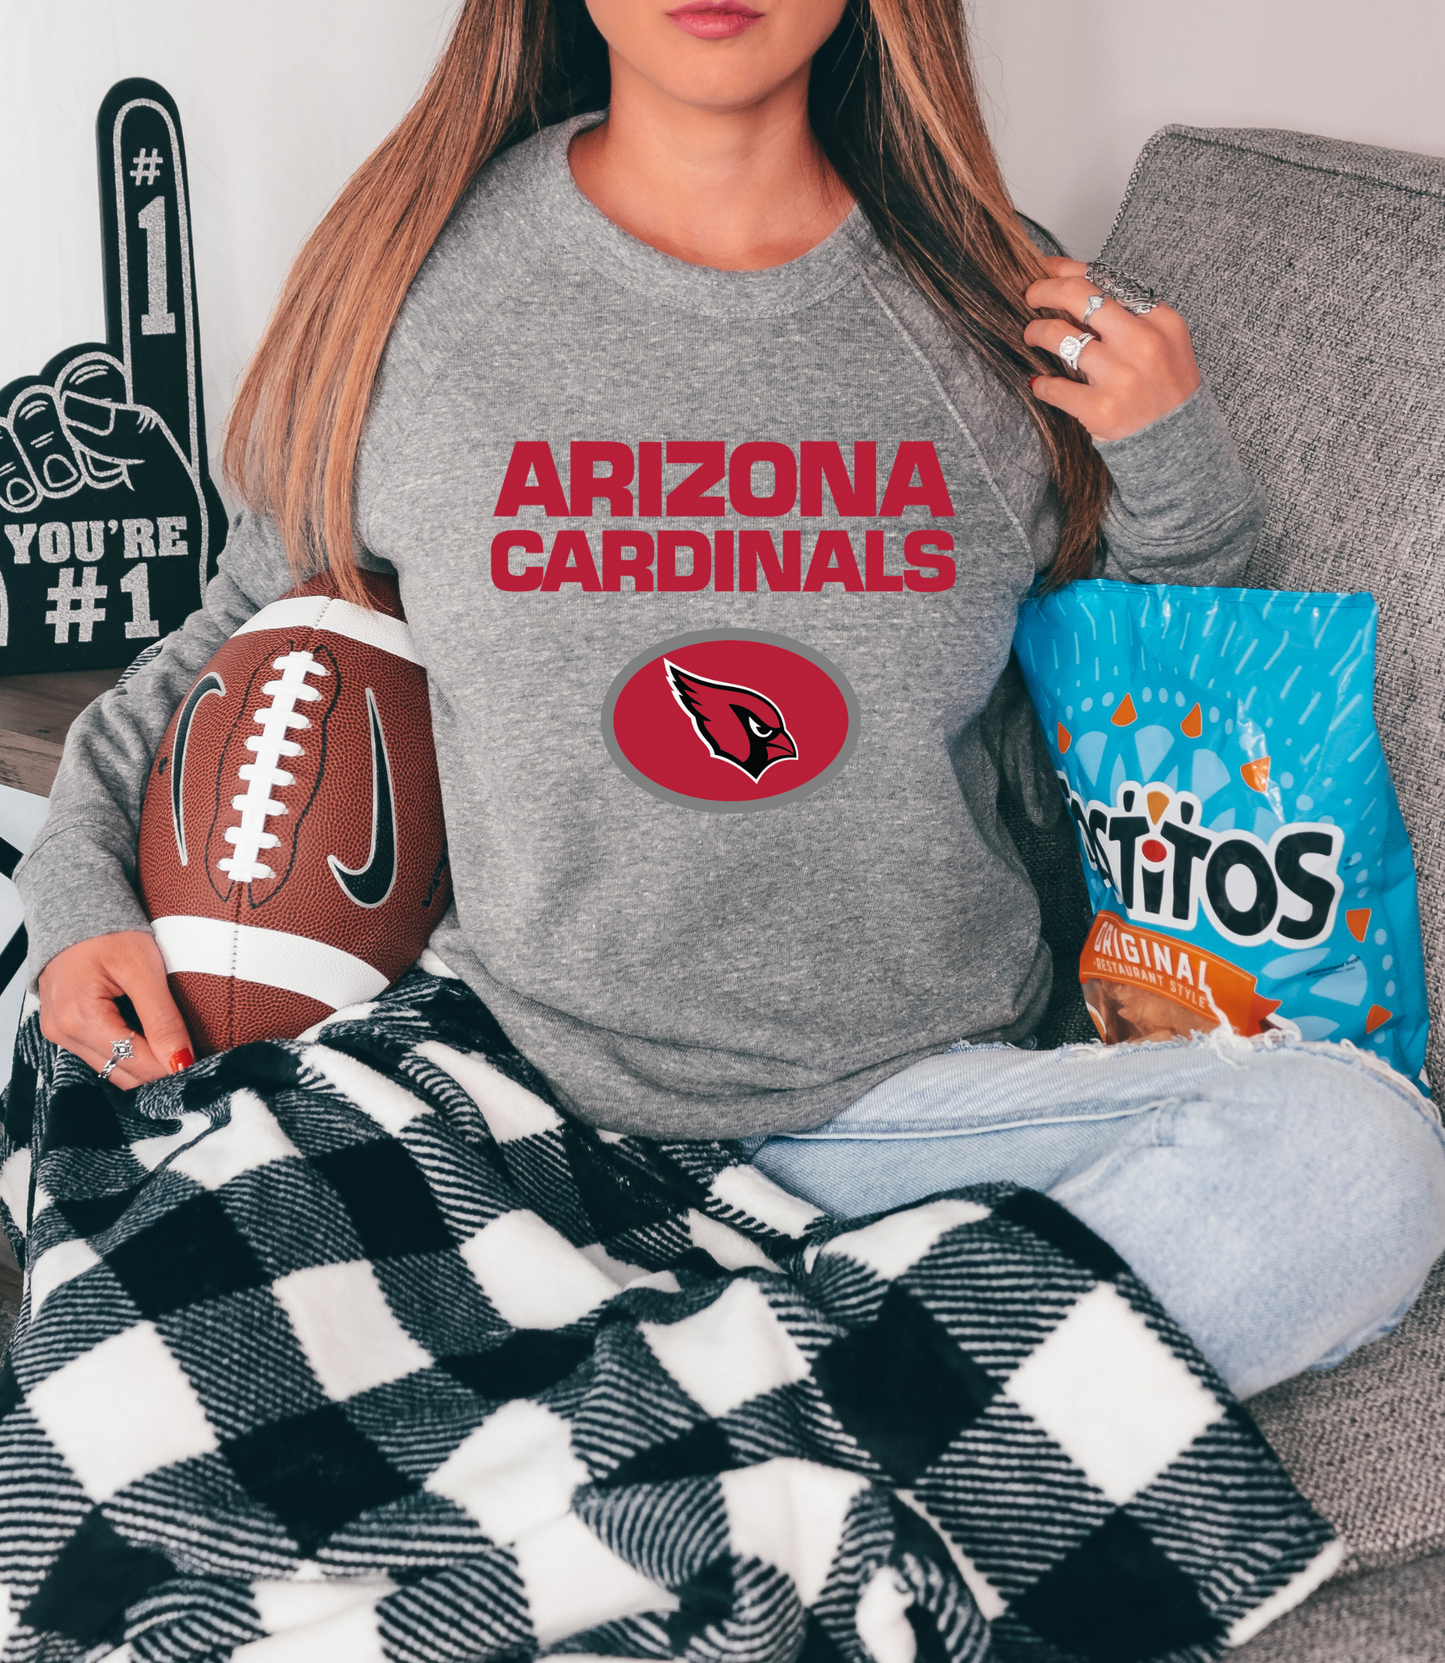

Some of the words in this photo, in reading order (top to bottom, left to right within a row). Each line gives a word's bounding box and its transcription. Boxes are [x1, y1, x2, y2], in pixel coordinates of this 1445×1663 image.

[494, 441, 955, 517] ARIZONA
[4, 516, 188, 564] YOU’RE
[491, 529, 956, 592] CARDINALS
[45, 562, 160, 644] #1
[1094, 921, 1209, 992] ORIGINAL
[1095, 958, 1163, 987] RESTAURANT
[1169, 980, 1206, 1009] STYLE
